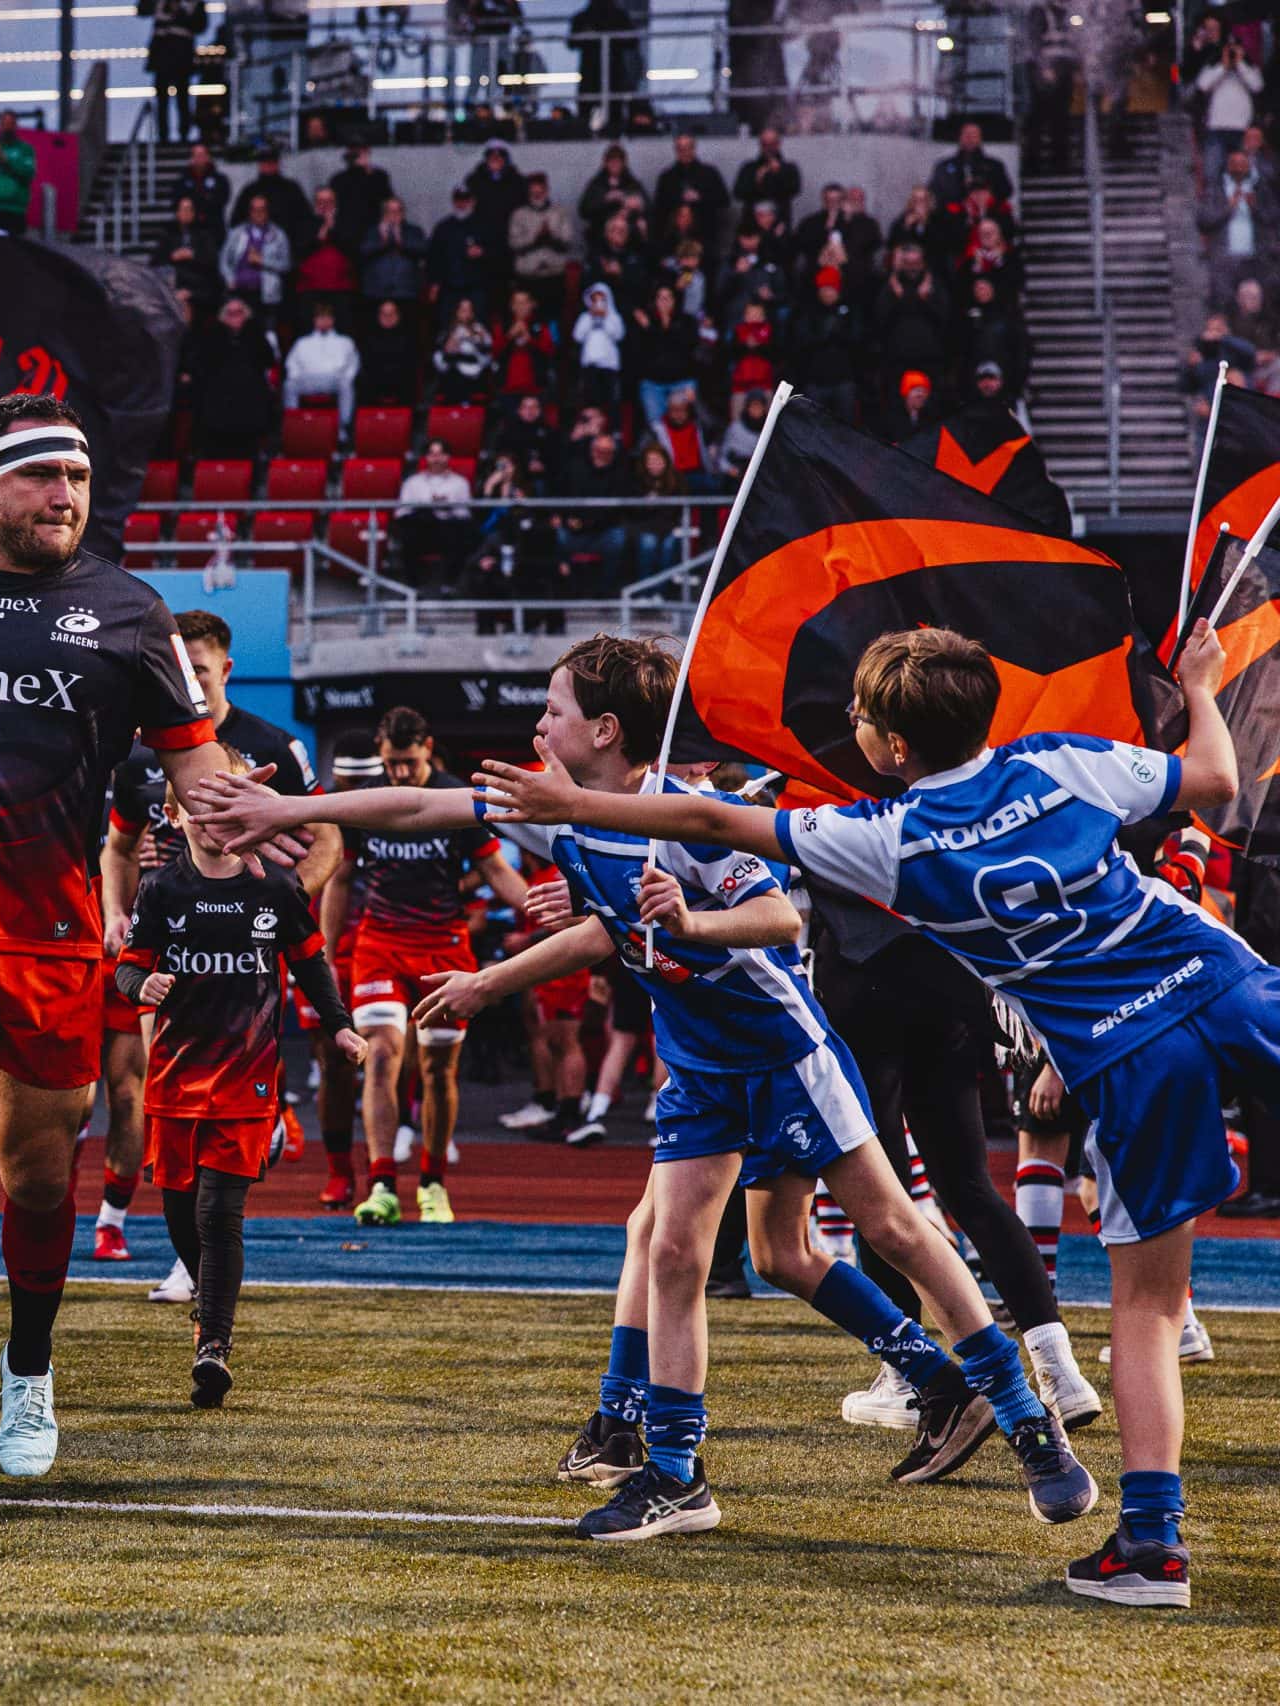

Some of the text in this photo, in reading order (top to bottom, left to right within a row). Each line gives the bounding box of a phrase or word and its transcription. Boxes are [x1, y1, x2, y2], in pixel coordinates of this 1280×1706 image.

[49, 631, 100, 650] SARACENS
[930, 793, 1040, 851] HOWDEN
[367, 837, 449, 860] StoneX
[195, 900, 246, 914] StoneX
[973, 855, 1087, 962] 9
[1091, 956, 1204, 1039] SKECHERS
